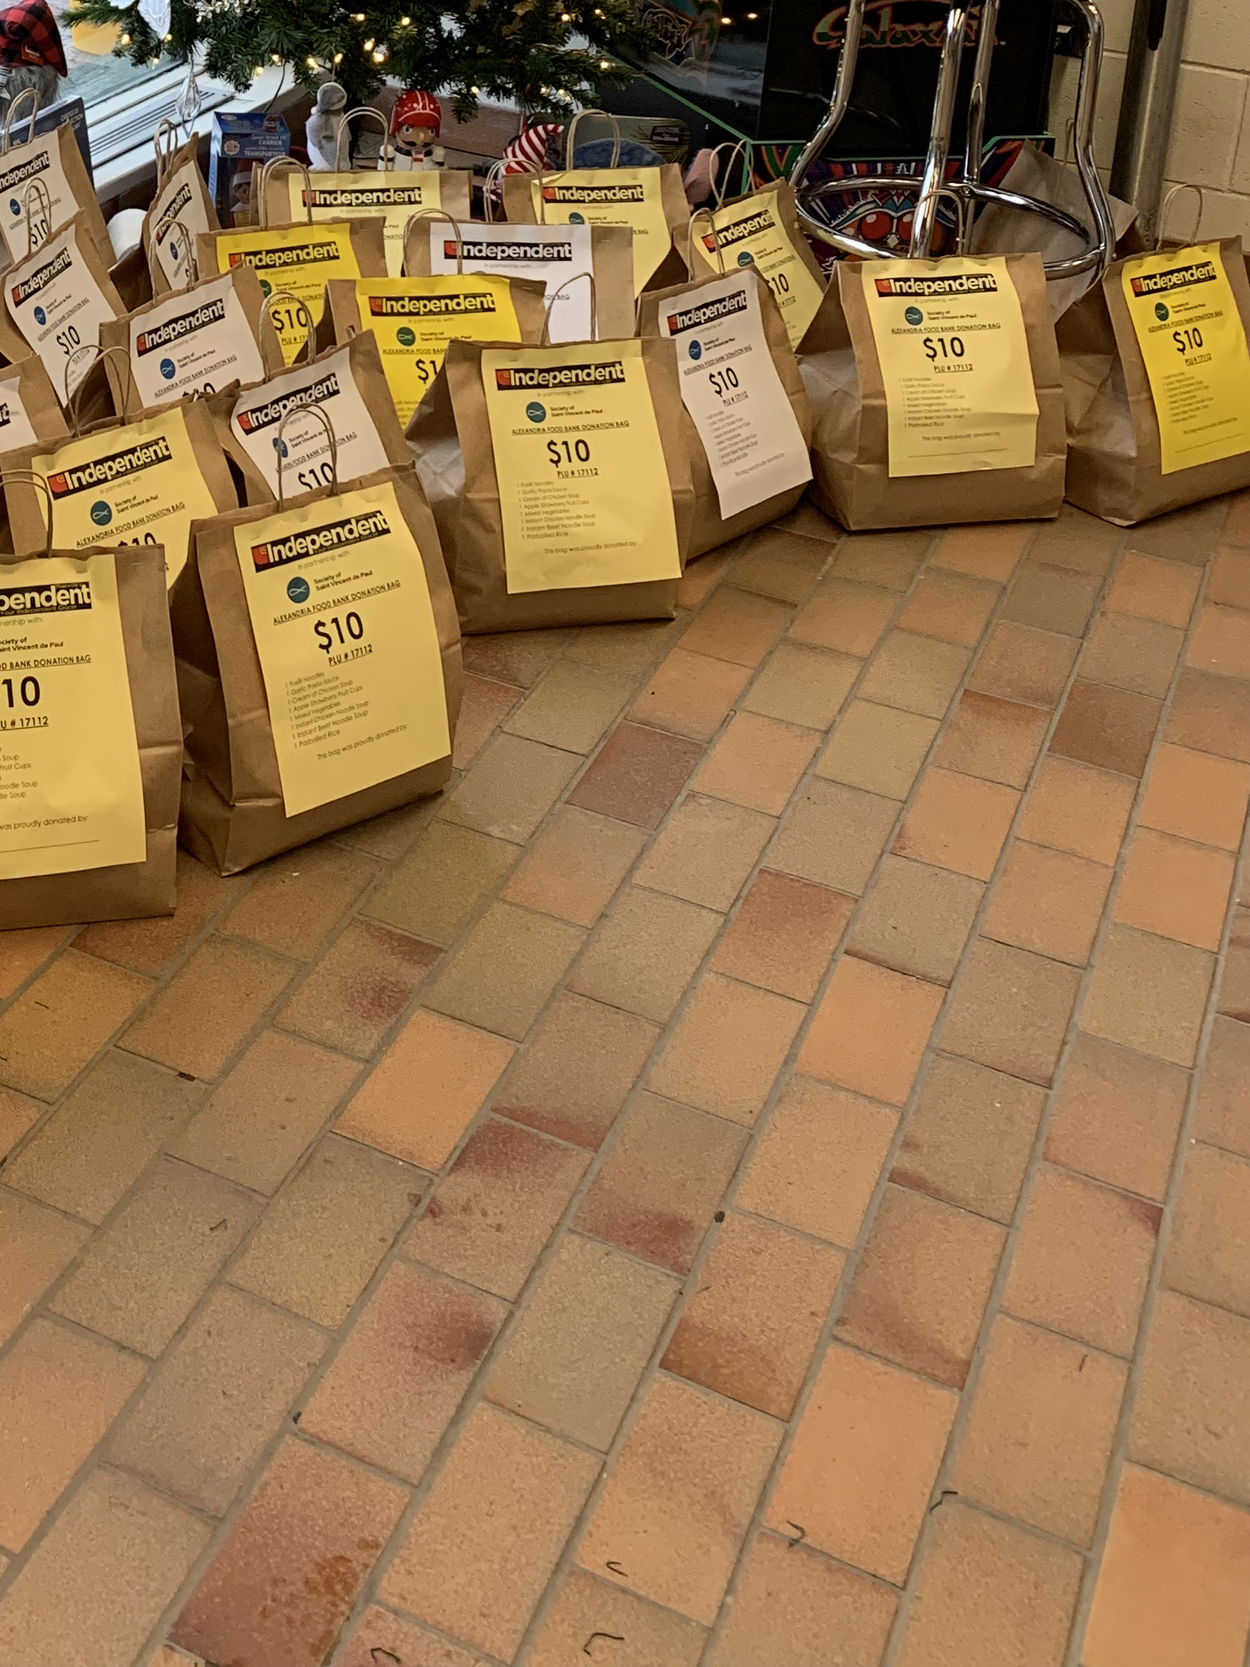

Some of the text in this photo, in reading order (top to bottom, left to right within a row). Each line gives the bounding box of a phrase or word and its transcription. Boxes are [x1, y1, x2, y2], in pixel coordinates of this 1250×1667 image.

[316, 188, 421, 205] Independent
[555, 187, 643, 202] Independent
[18, 249, 71, 298] Independent
[891, 275, 996, 295] Independent
[1141, 263, 1216, 292] Independent
[382, 294, 495, 315] Independent
[675, 292, 747, 332] Independent
[145, 300, 224, 345] Independent
[56, 325, 81, 358] $10
[922, 336, 965, 362] $10
[1173, 327, 1204, 356] $10
[510, 362, 624, 388] Independent
[709, 366, 739, 397] $10
[248, 375, 339, 426] Independent
[67, 439, 171, 489] Independent
[547, 439, 590, 467] $10
[557, 468, 598, 478] PLU 17112
[267, 512, 388, 563] Independent
[314, 612, 363, 654] $10
[13, 644, 38, 652] Vincent
[329, 644, 373, 666] PLU 17112
[10, 660, 31, 669] BANK
[34, 657, 74, 667] DONATION
[76, 655, 91, 663] BAG
[11, 719, 16, 727] #
[20, 716, 48, 727] 17112
[14, 820, 41, 830] proudly
[43, 816, 76, 825] donated
